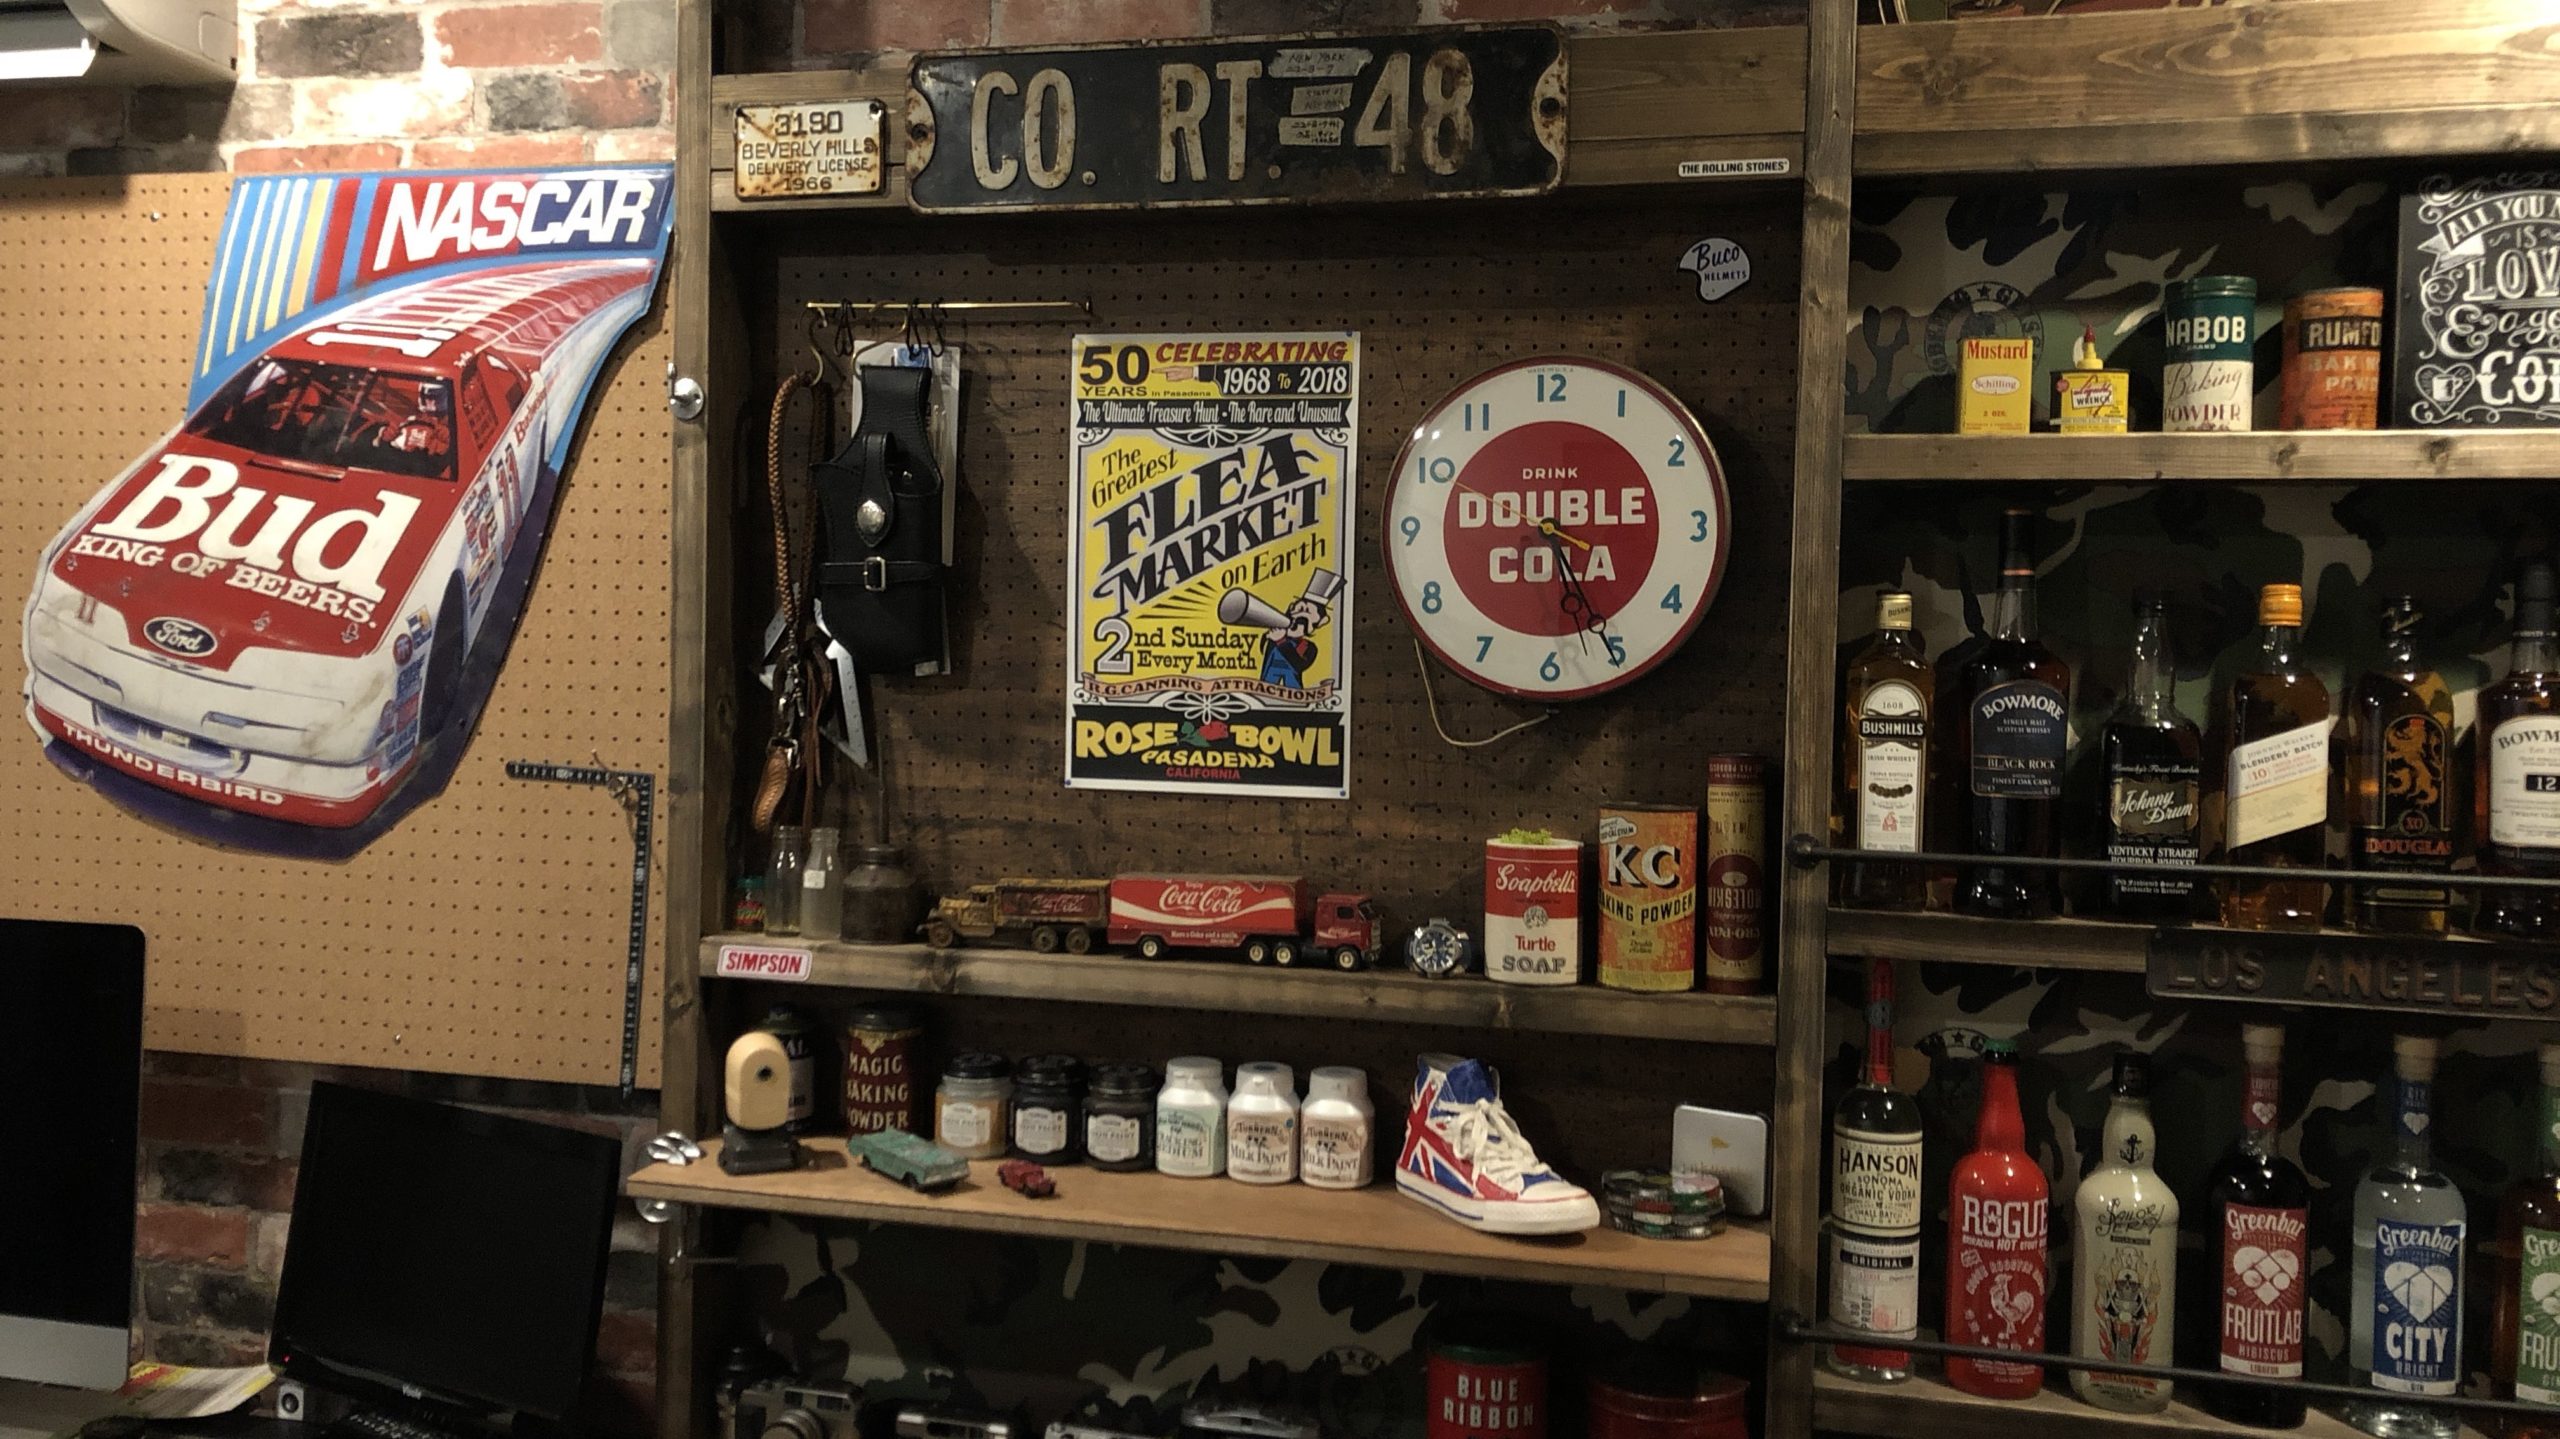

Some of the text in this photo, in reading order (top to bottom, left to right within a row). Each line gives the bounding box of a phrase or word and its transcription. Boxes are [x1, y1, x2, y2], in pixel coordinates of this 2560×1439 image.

[774, 111, 843, 136] 3190
[971, 49, 1474, 191] CO. RT. 48
[742, 137, 877, 160] BEVERLY HILLS
[748, 158, 870, 176] DELIVERY LICENSE
[1682, 161, 1788, 174] THE ROLLING STONES
[784, 177, 833, 191] 1966
[374, 178, 654, 271] NASCAR
[2448, 194, 2545, 246] ALL YOU
[2516, 225, 2537, 249] IS
[1692, 245, 1741, 271] Buco
[1704, 271, 1748, 282] HELMETS
[2165, 315, 2247, 348] NABOB
[1155, 342, 1347, 363] CELEBRATING
[1967, 340, 2028, 360] Mustard
[1080, 344, 1150, 386] 50
[1081, 385, 1148, 397] YEARS
[1222, 366, 1348, 395] 1968 To 2018
[1537, 374, 1567, 402] 12
[1974, 379, 2017, 390] Schilling
[2166, 361, 2242, 403] Baking
[1083, 402, 1342, 424] The Ultimate Treasure Hunt The Rare and Unusual
[1617, 390, 1626, 418] 1
[2076, 396, 2112, 406] WRENCH
[2164, 403, 2241, 424] POWDER
[1464, 403, 1490, 431] 11
[1102, 448, 1142, 477] The
[1667, 438, 1685, 467] 2
[1092, 447, 1179, 509] Greatest
[1418, 457, 1456, 484] 10
[1522, 467, 1579, 480] DRINK
[1093, 433, 1319, 575] FLEA
[1458, 487, 1646, 528] DOUBLE
[92, 453, 424, 601] Bud
[1400, 516, 1421, 546] 9
[1690, 510, 1708, 542] 3
[1093, 478, 1327, 618] MARKET
[1221, 532, 1327, 590] on Earth
[1489, 545, 1617, 583] COLA
[70, 533, 379, 629] KING OF BEERS.
[1421, 581, 1442, 614] 8
[1660, 584, 1683, 614] 4
[153, 620, 206, 652] Ford
[1171, 626, 1259, 656] Sunday
[1476, 636, 1494, 663] 7
[1136, 650, 1258, 674] Every Month
[1607, 636, 1626, 666] 5
[1540, 652, 1561, 682] 6
[1211, 679, 1327, 701] ATTRACTIONS
[1882, 701, 1904, 710] 1608
[1981, 694, 2065, 721] BOWMORE
[1861, 719, 1924, 737] BUSHMILLS
[2003, 718, 2027, 726] SINGLE
[1075, 719, 1341, 767] ROSE BOWL
[2240, 749, 2290, 770] BLENDERS'
[2294, 739, 2324, 754] BATCH
[62, 721, 285, 806] THUNDERBIRD
[1140, 749, 1277, 769] PASADENA
[1867, 755, 1916, 763] IRISH WHISKEY
[1987, 758, 2056, 769] BLACK ROCK
[1166, 768, 1241, 780] CALIFORNIA
[1991, 777, 2016, 785] FINEST
[2252, 767, 2268, 781] 10
[2536, 776, 2557, 791] 12
[2119, 789, 2175, 817] Johnny
[2143, 802, 2194, 826] Drum
[2107, 845, 2199, 859] KENTUCKY STRAIGHT
[1608, 843, 1681, 889] KC
[1159, 884, 1245, 914] Coca-Cola
[1641, 891, 1693, 925] POWDER
[1515, 935, 1557, 952] Turtle
[726, 951, 803, 974] SIMPSON
[1502, 955, 1567, 974] SOAP
[2167, 948, 2559, 1012] LOS ANGELES
[848, 1052, 903, 1077] MAGIC
[1231, 1144, 1254, 1162] MILK
[1839, 1147, 1919, 1181] HANSON
[1840, 1183, 1916, 1201] ORGANIC VODKA
[1856, 1176, 1903, 1187] SONOMA
[1962, 1194, 2049, 1239] ROGUE
[2226, 1207, 2306, 1241] Greenbar
[1996, 1238, 2018, 1252] HOT
[2378, 1223, 2459, 1256] Greenbar
[1851, 1254, 1904, 1268] ORIGINAL
[1861, 1296, 1873, 1329] PROOF
[2224, 1302, 2302, 1345] FRUITLAB
[2238, 1344, 2290, 1361] HIBISCUS
[2385, 1321, 2449, 1364] CITY
[2249, 1363, 2279, 1375] LIQUEUR
[2396, 1362, 2441, 1377] BRIGHT
[1457, 1374, 1519, 1402] BLUE
[2410, 1382, 2425, 1392] GIN
[1443, 1396, 1534, 1428] RIBBON
